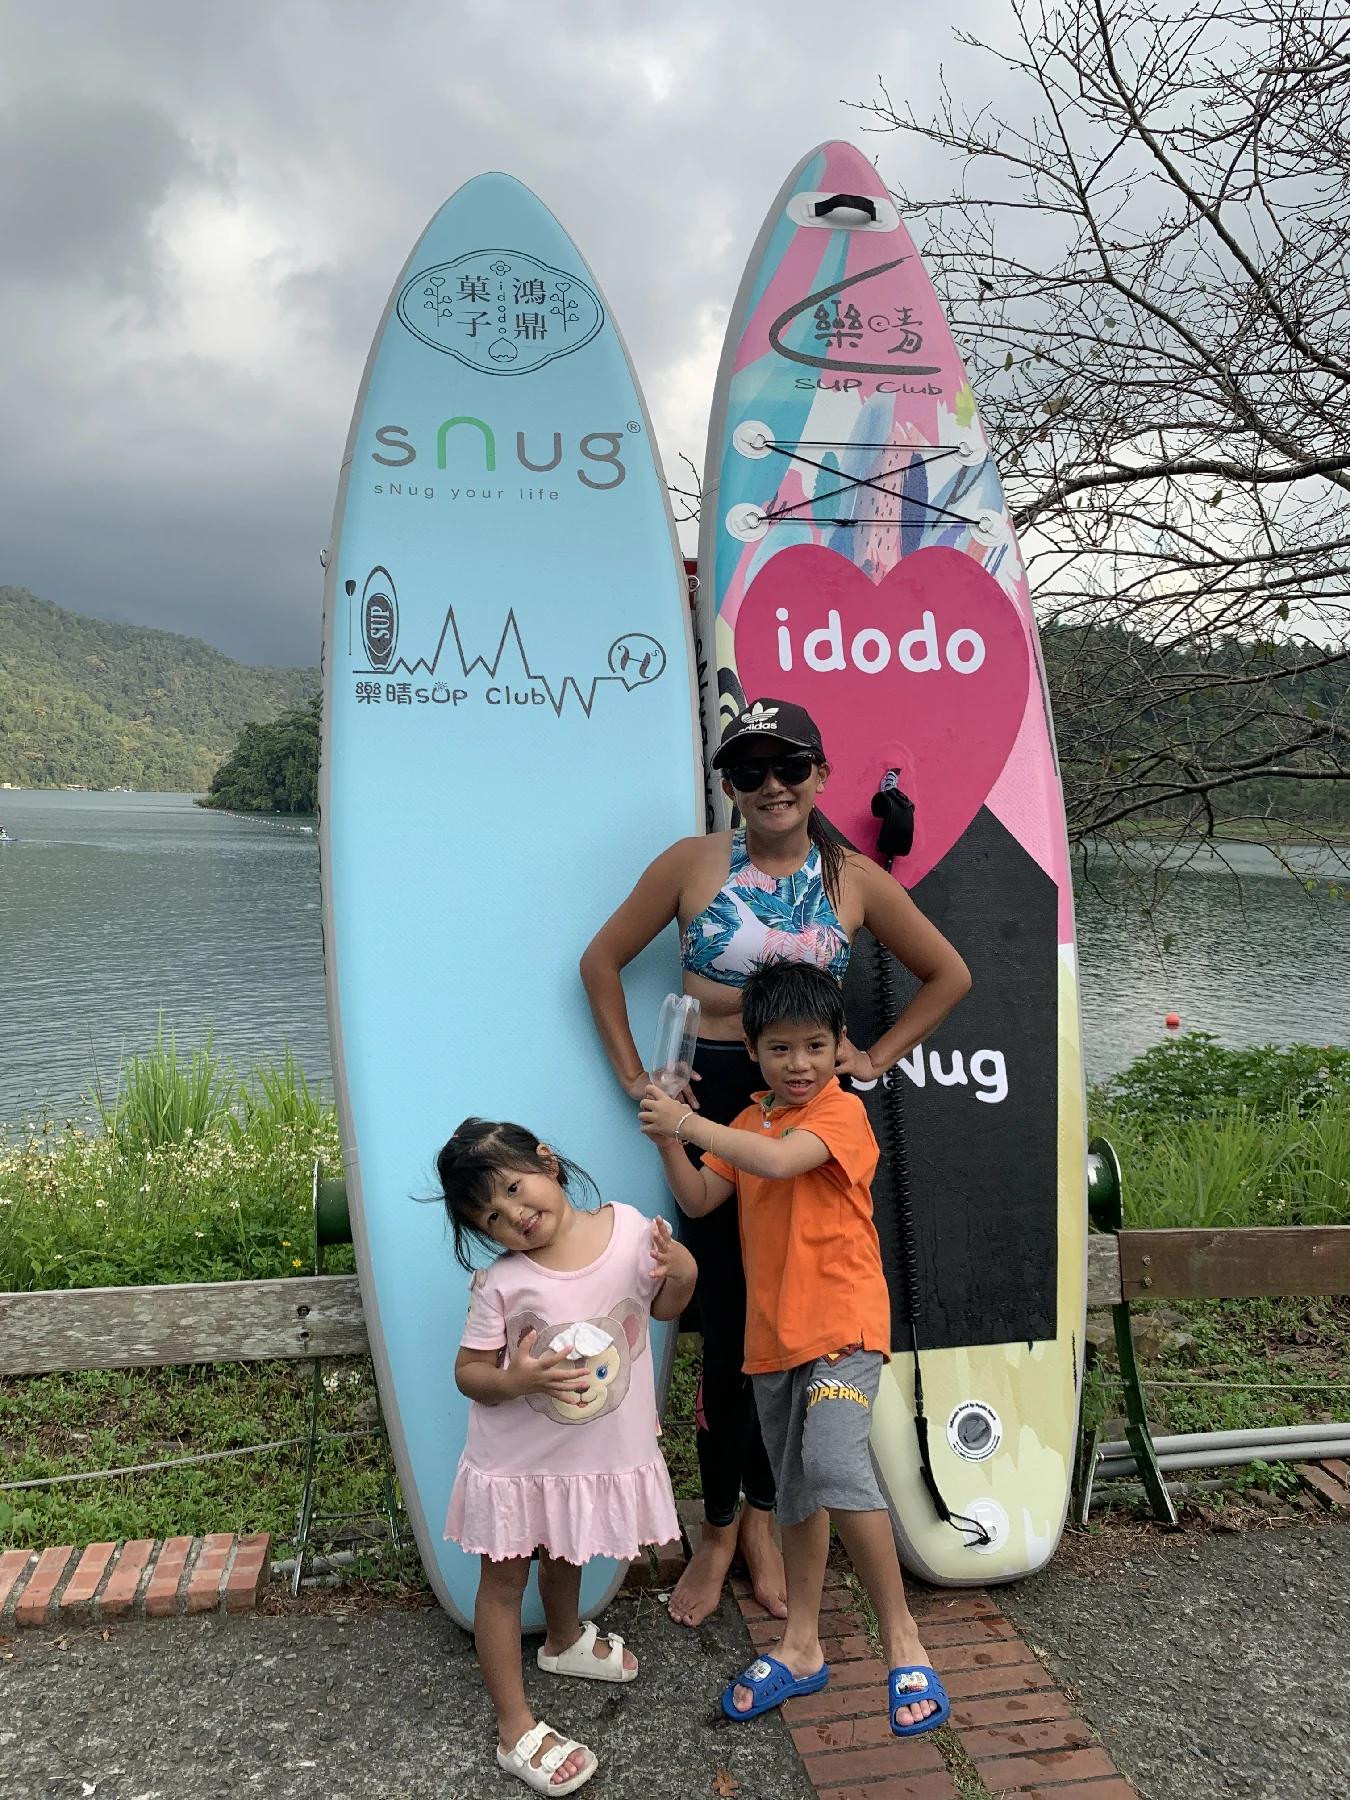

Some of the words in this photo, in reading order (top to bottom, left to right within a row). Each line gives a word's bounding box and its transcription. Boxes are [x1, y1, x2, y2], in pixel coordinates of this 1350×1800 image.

[456, 275, 492, 338] 菓子
[512, 277, 548, 340] 鴻鼎
[875, 380, 943, 396] Club
[374, 483, 435, 500] sNug
[450, 486, 505, 501] your
[519, 486, 560, 501] life
[369, 605, 391, 640] SUP
[775, 606, 987, 675] idodo
[485, 685, 546, 706] Club
